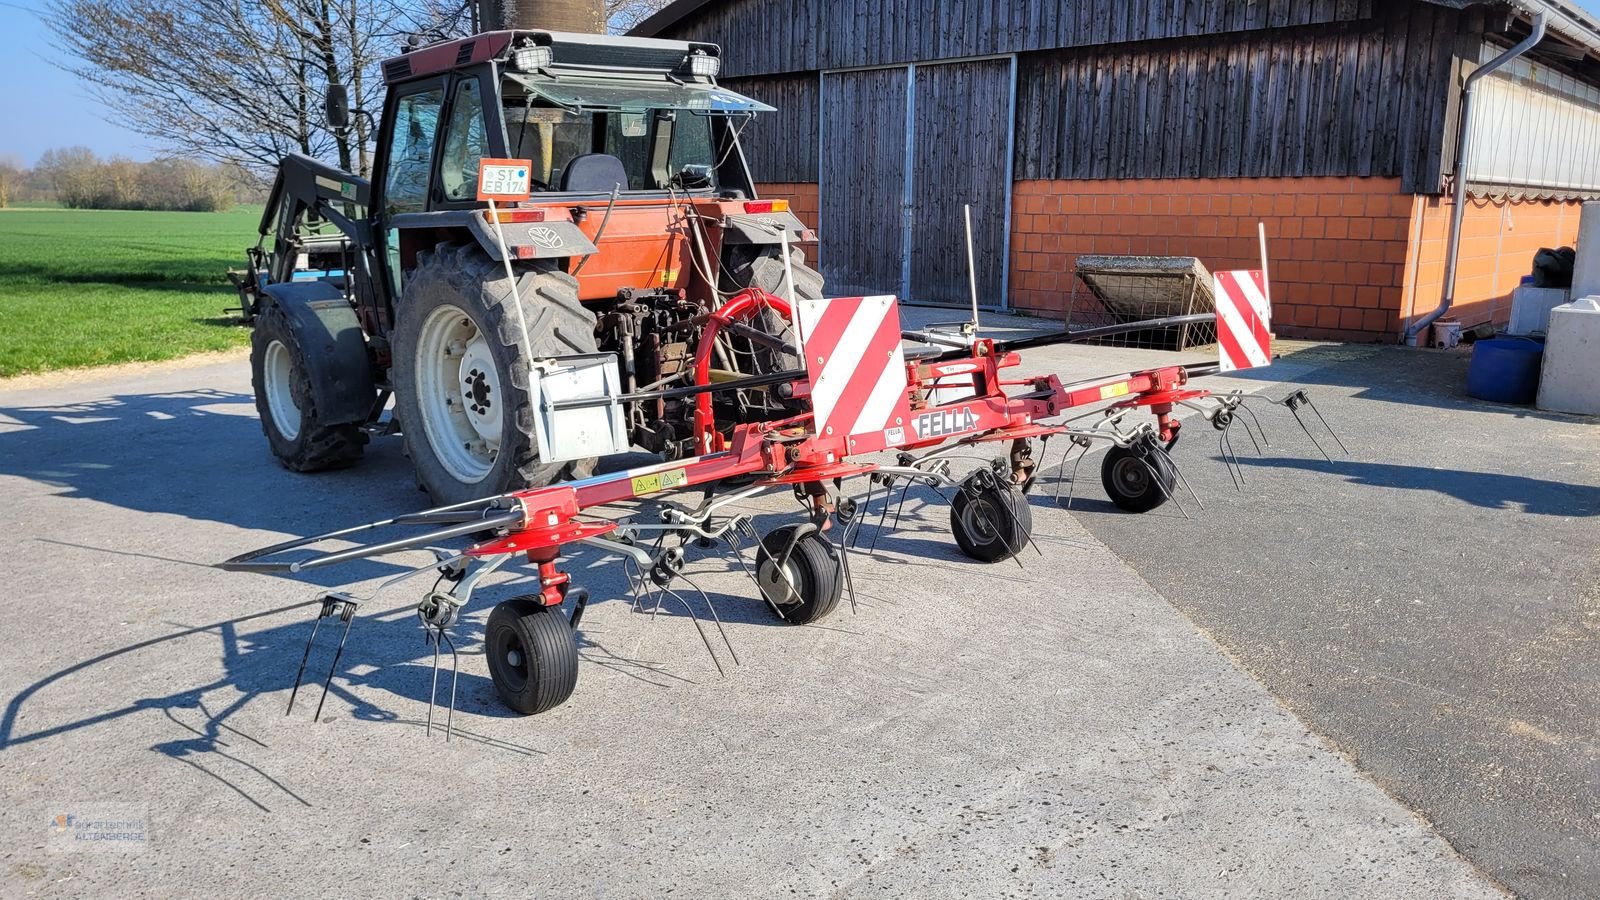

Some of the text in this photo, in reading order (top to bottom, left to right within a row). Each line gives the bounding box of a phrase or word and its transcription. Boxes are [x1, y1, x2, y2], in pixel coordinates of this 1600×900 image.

[498, 169, 514, 181] ST
[486, 181, 525, 192] EB 174
[919, 406, 977, 439] FELLA
[887, 428, 901, 437] FELLA
